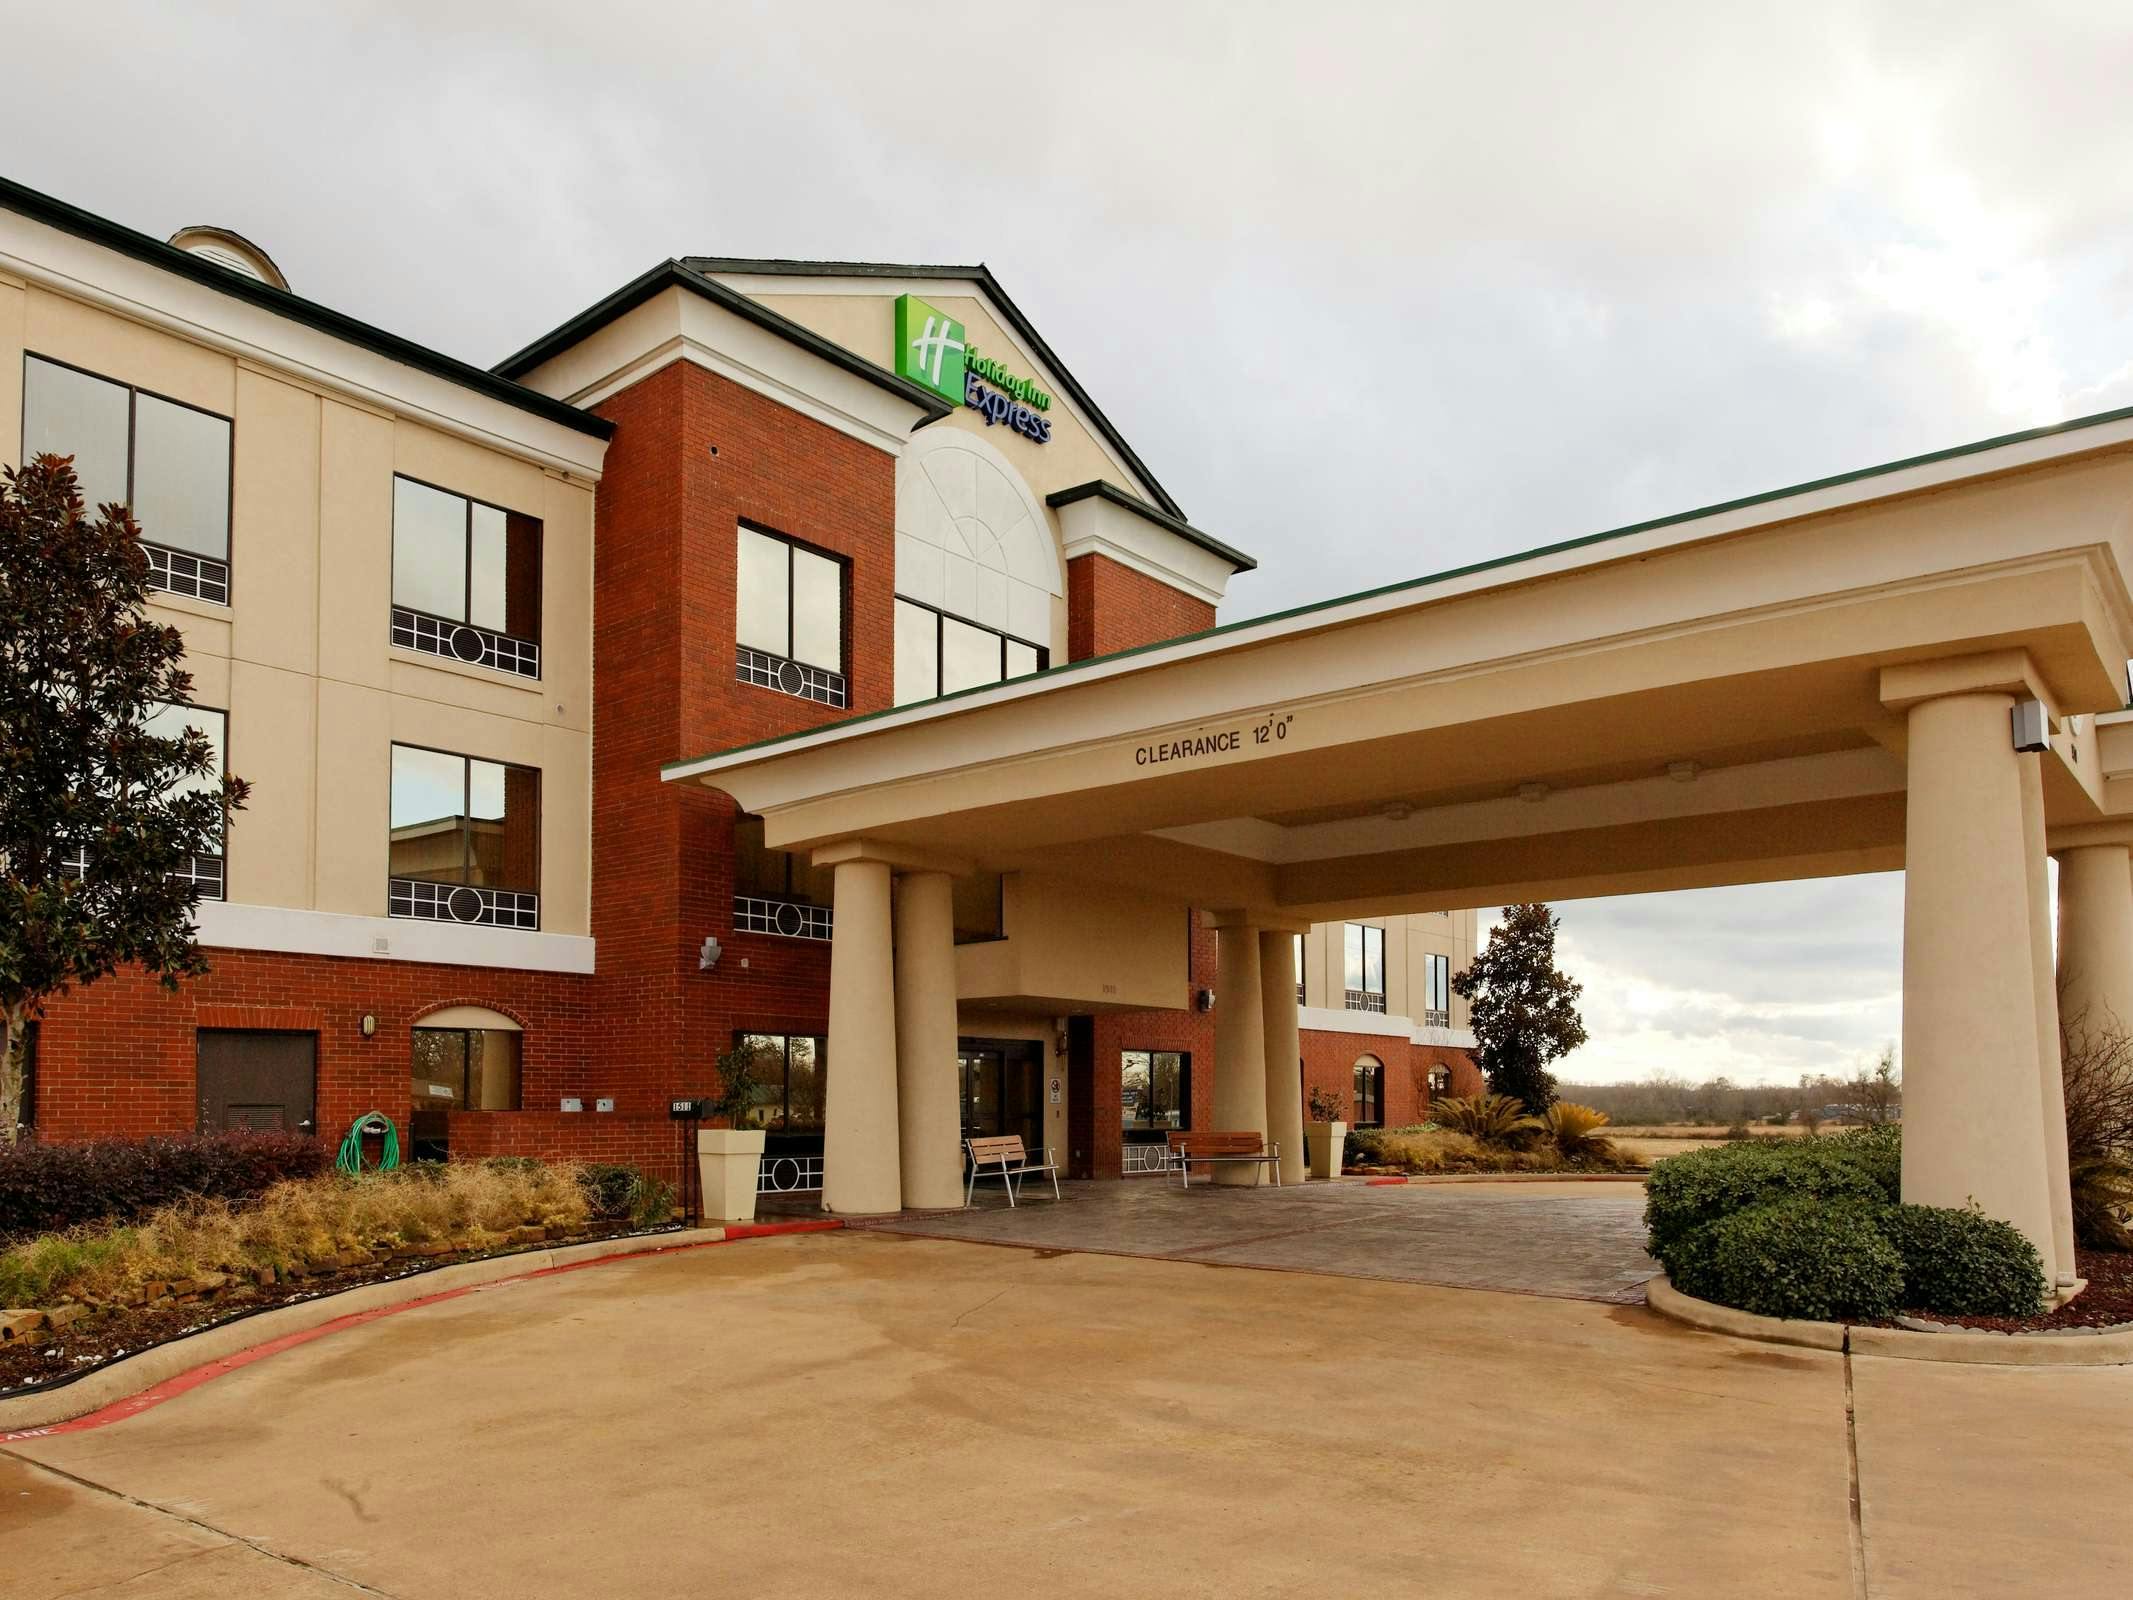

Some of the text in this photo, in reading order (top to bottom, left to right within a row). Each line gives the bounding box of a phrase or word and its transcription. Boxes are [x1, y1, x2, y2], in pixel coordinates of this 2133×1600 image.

[964, 343, 1053, 411] Holiday Inn
[964, 370, 1053, 444] Express
[1135, 731, 1241, 766] CLEARANCE
[673, 1102, 691, 1111] 1511
